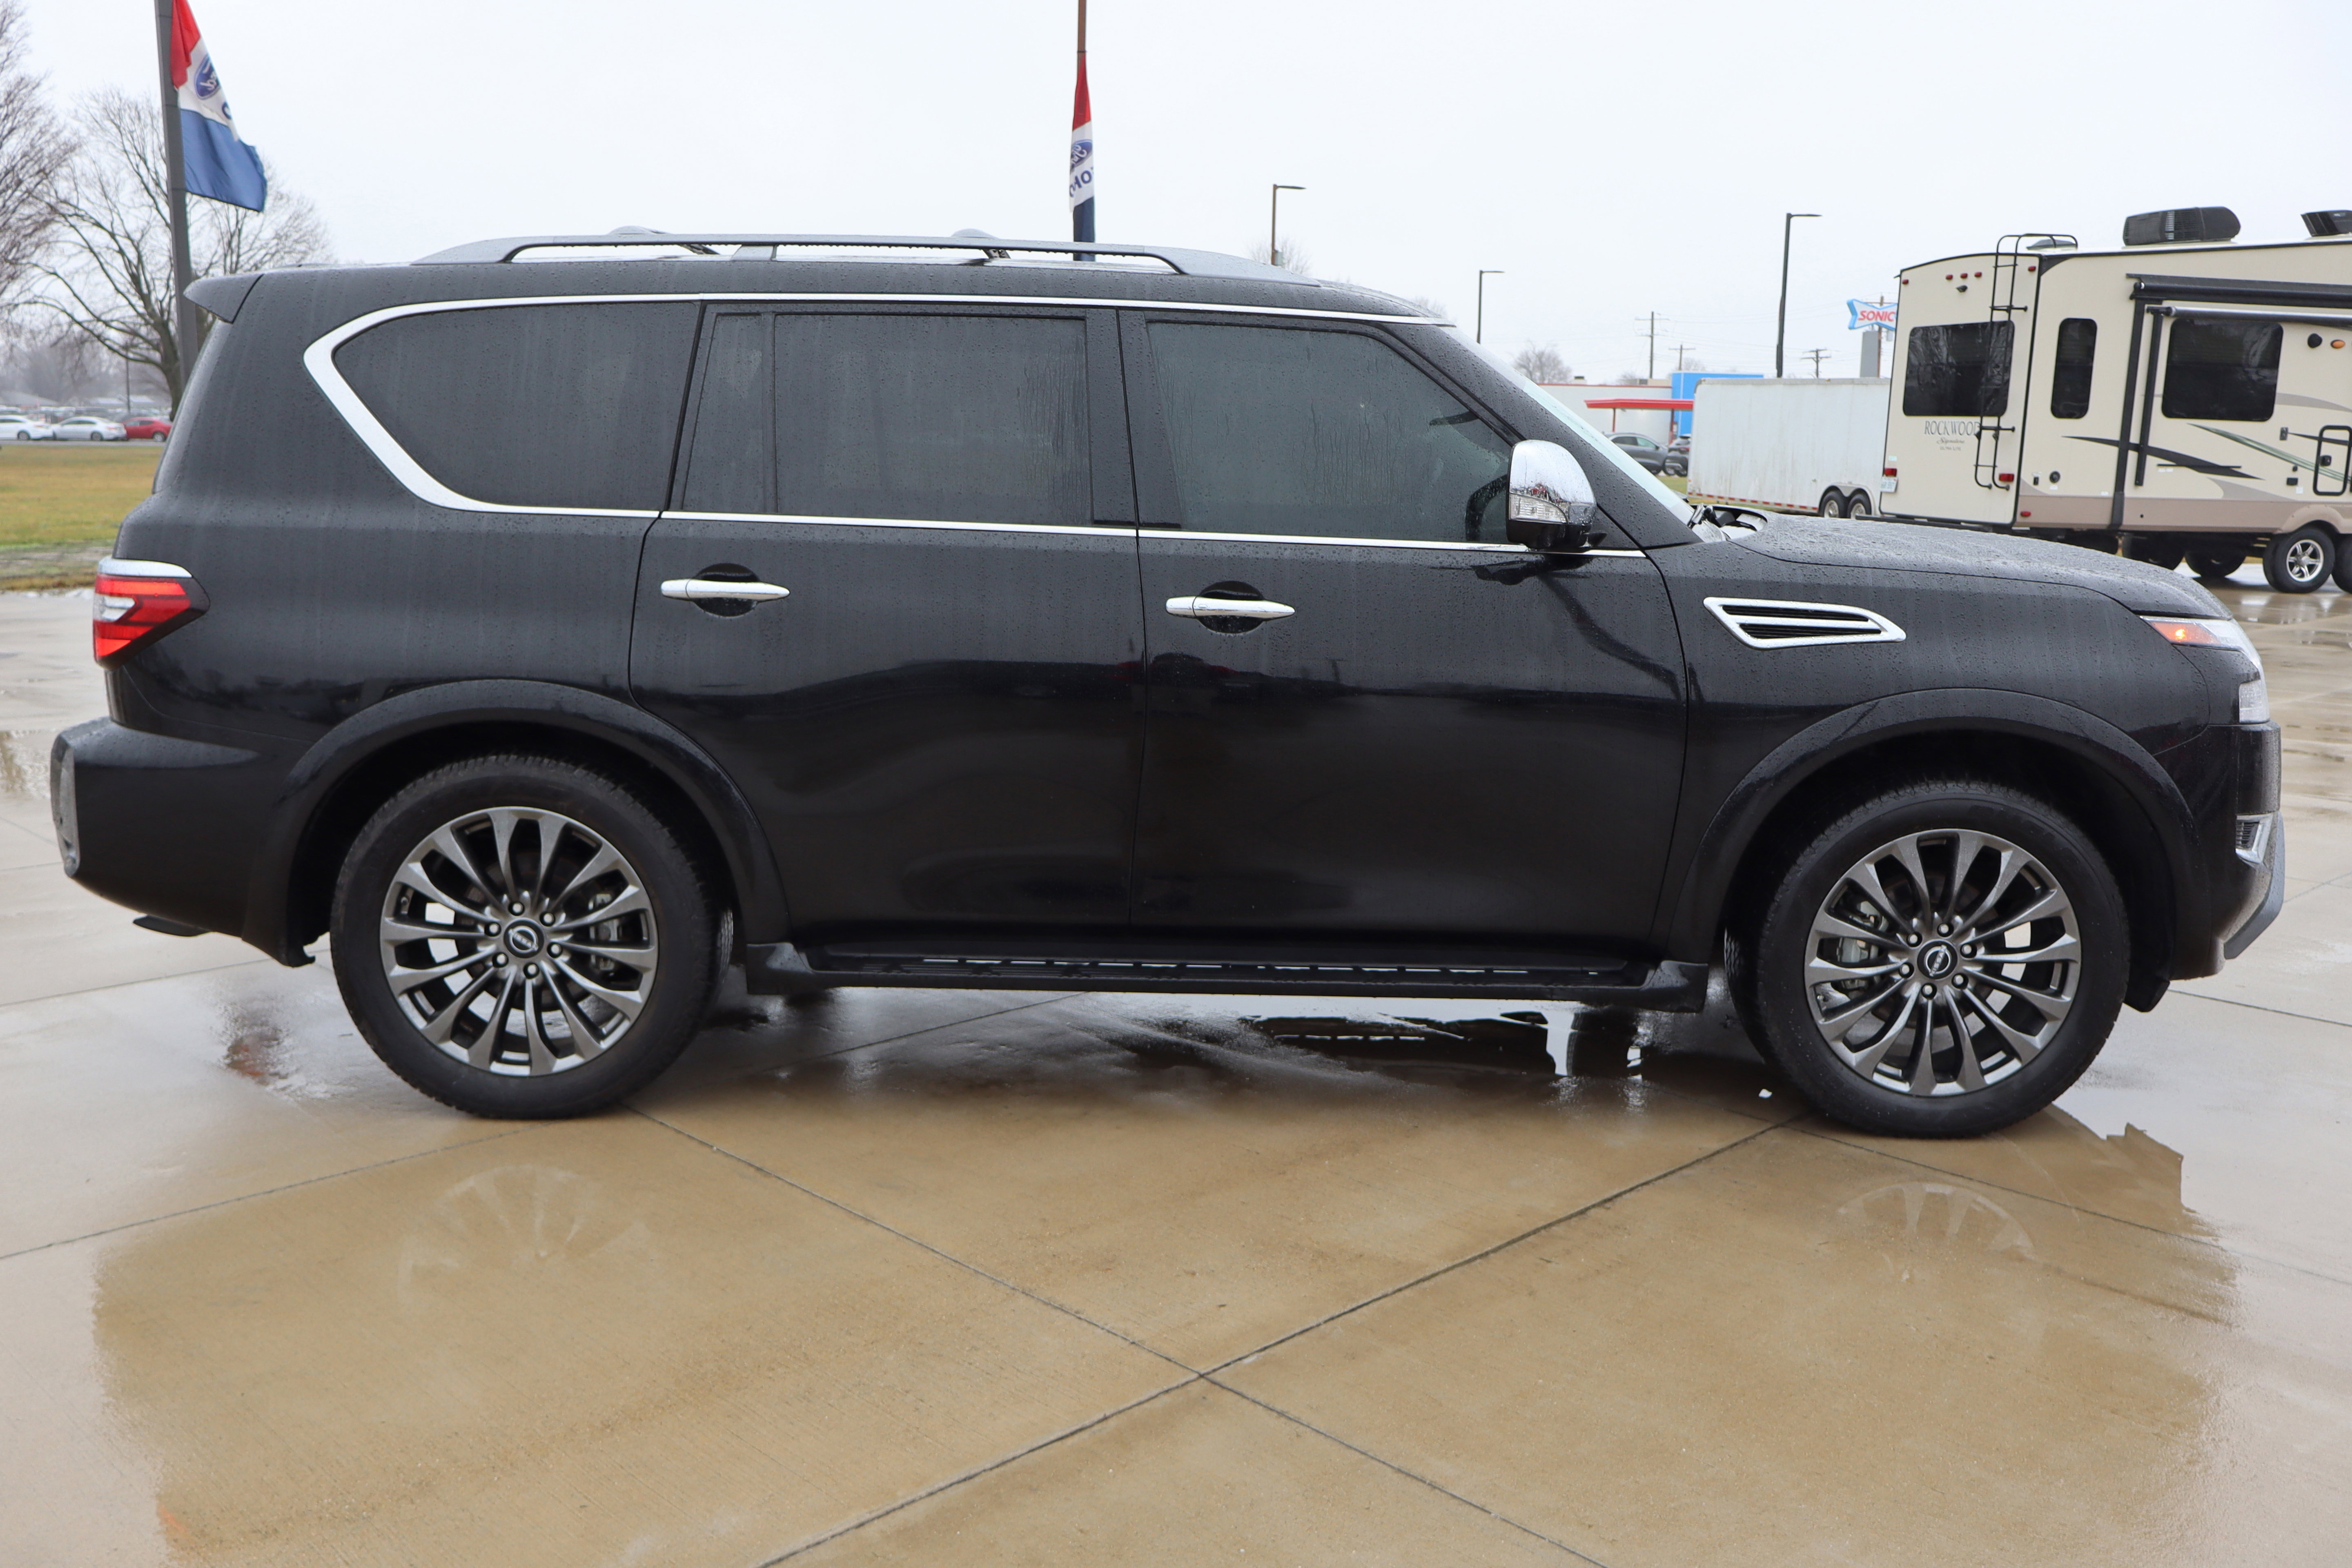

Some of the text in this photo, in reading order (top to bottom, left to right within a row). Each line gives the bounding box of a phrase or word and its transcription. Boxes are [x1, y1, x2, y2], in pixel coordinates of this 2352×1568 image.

[1858, 310, 1895, 322] SONIC
[1924, 420, 1981, 436] ROCKWOOD
[508, 929, 539, 951] NISSAN
[1929, 944, 1947, 977] NISSAN
